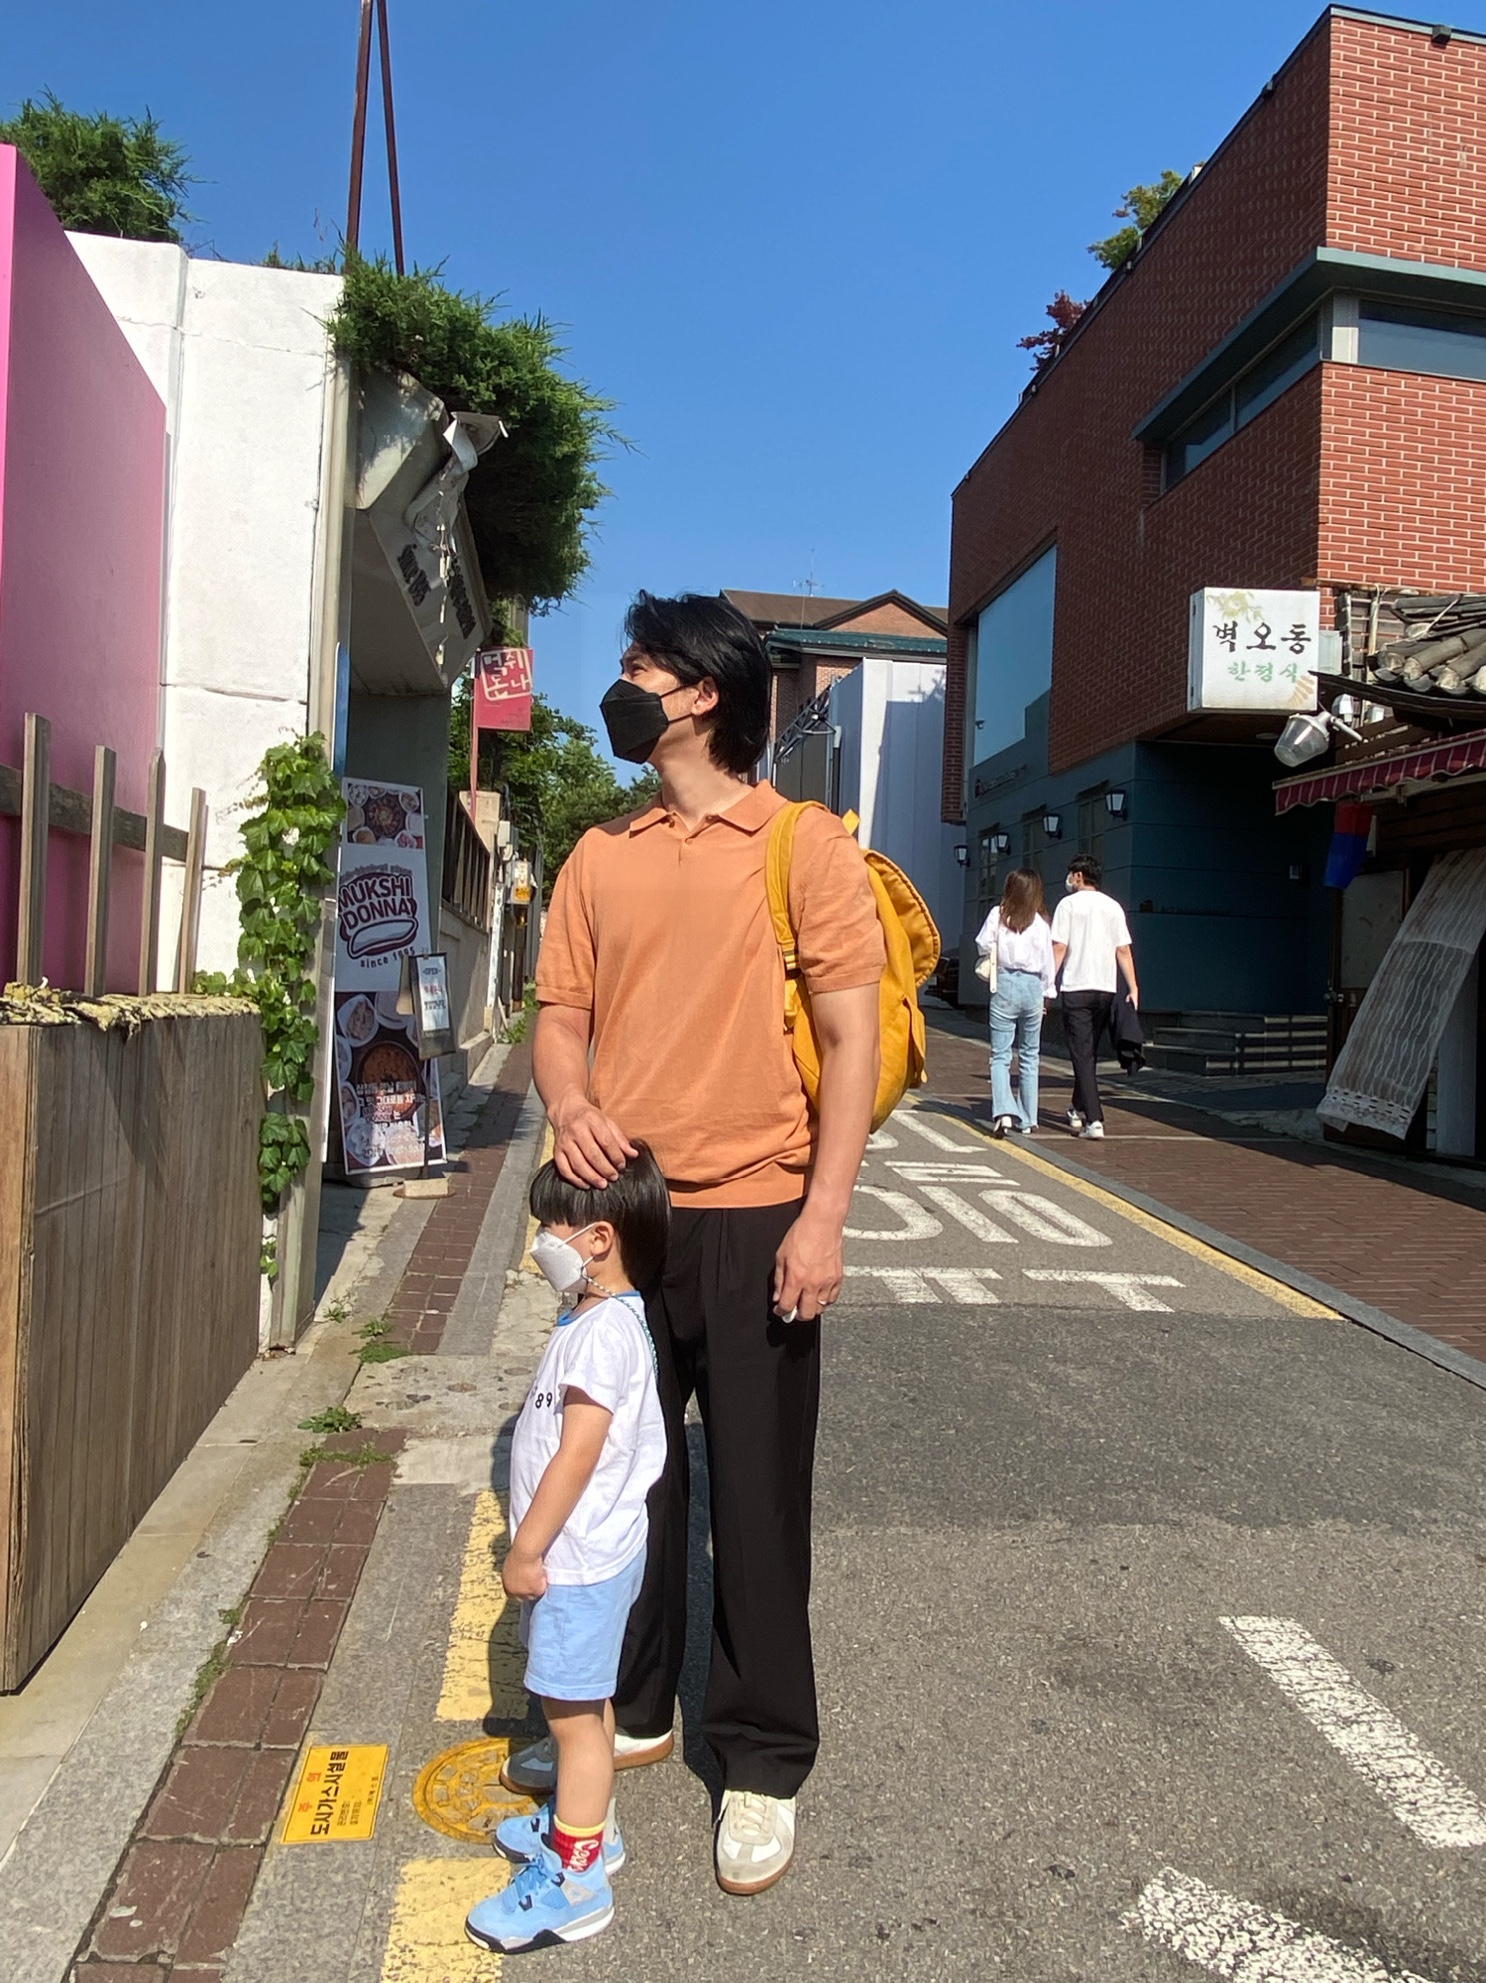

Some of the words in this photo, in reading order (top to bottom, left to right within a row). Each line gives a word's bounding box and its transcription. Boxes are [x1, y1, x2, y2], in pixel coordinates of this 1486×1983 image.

[338, 878, 411, 912] MUKSHI
[343, 899, 412, 930] DONNA
[360, 956, 389, 968] since
[310, 1750, 350, 1836] 도시가스시설물
